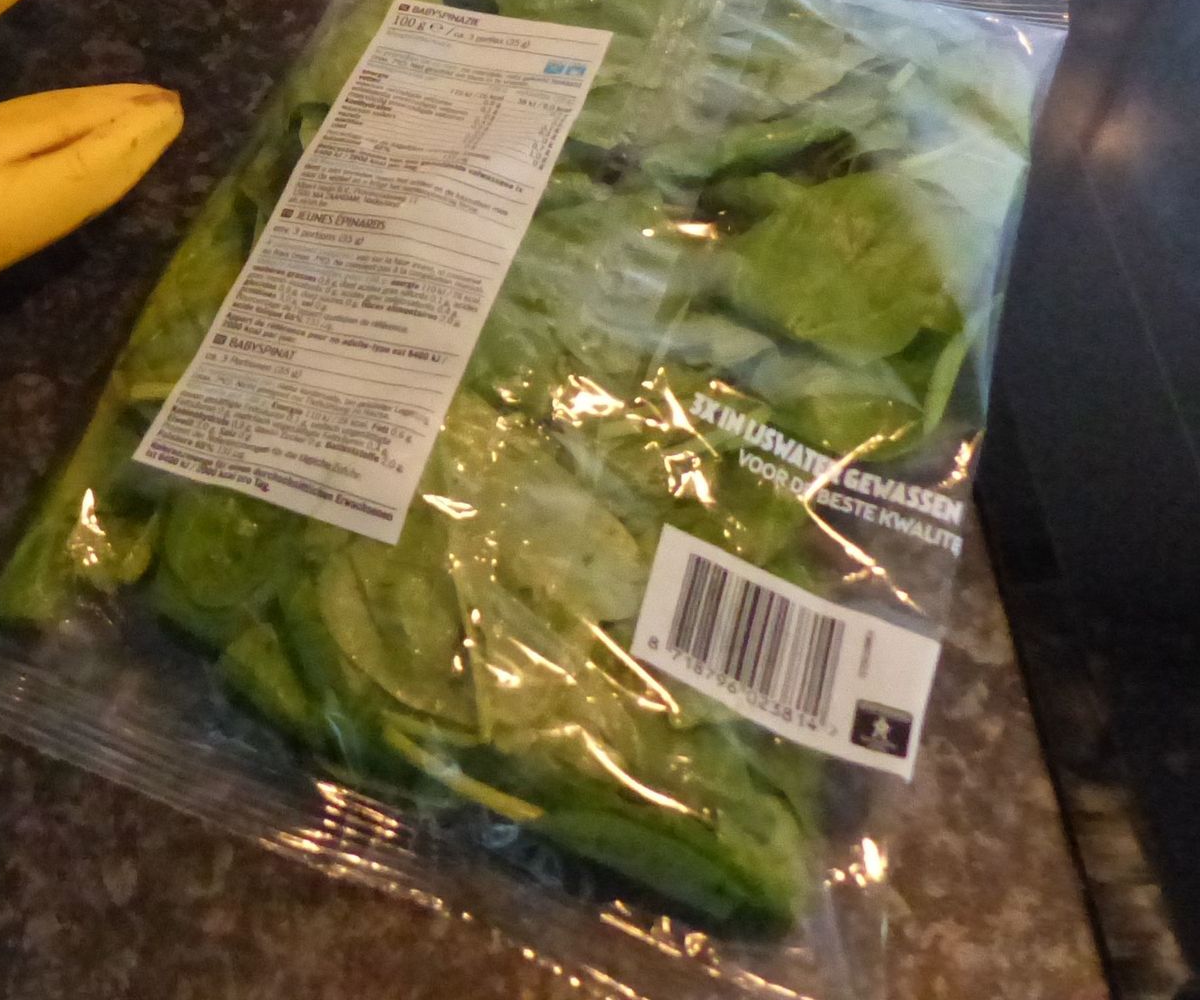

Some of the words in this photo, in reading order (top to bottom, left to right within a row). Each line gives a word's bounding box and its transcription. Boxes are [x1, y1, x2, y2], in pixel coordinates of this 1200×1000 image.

[392, 15, 416, 27] 100
[411, 5, 479, 25] BABYSPINAZIE
[227, 337, 295, 361] BABYSPINAT
[739, 448, 789, 487] VOOR
[816, 488, 878, 523] BESTE
[843, 468, 965, 526] GEWASSEN
